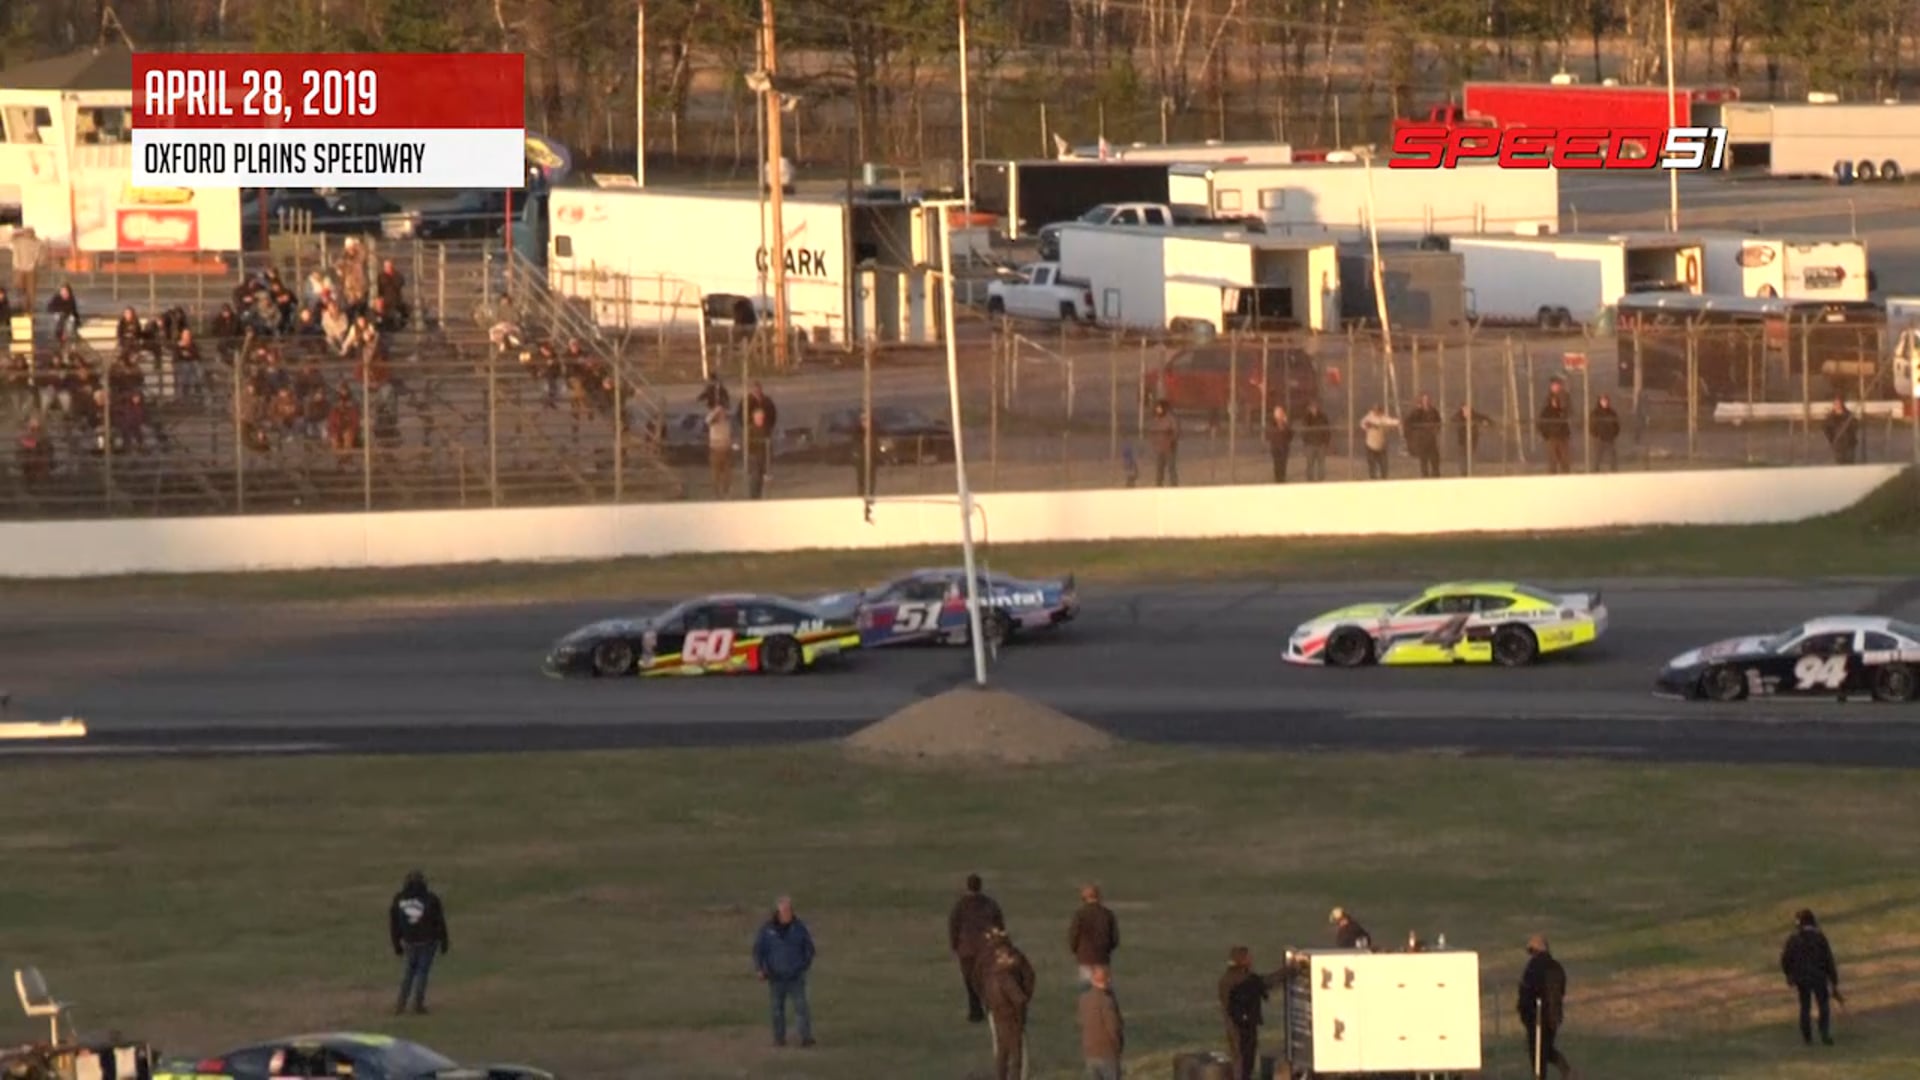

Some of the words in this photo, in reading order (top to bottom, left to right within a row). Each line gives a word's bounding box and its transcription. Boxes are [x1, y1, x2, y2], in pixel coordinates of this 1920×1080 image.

[892, 601, 943, 632] 51
[1422, 612, 1470, 650] 4
[682, 628, 735, 662] 60
[1794, 654, 1849, 689] 94
